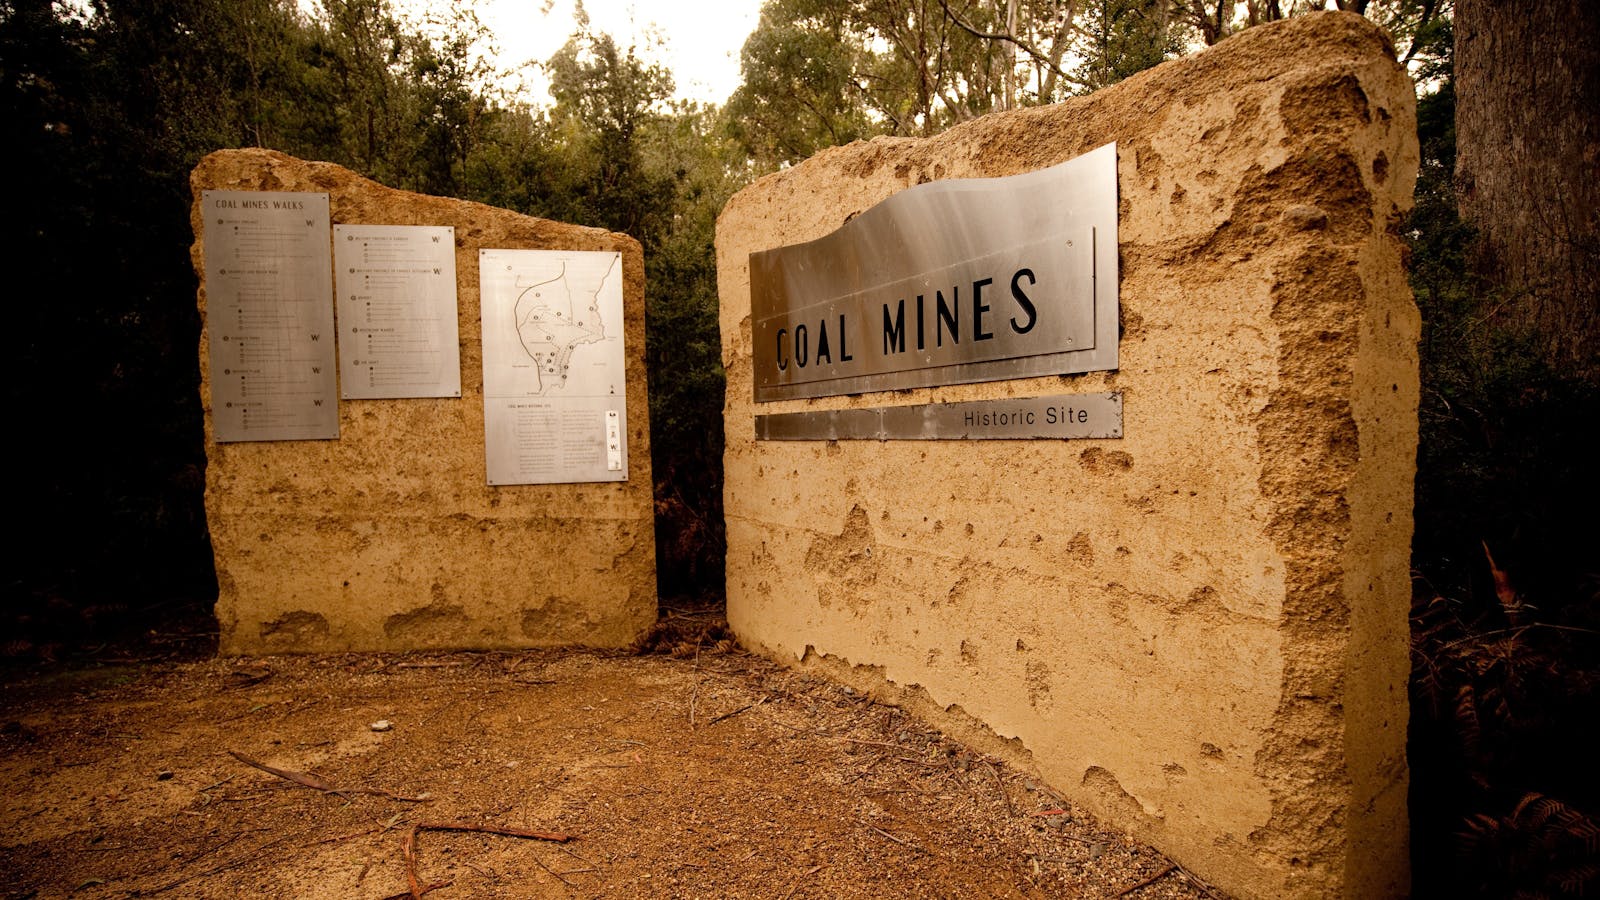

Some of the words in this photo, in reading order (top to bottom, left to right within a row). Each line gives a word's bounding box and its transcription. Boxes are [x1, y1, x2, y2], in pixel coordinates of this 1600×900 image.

[215, 199, 238, 209] COAL
[242, 200, 269, 209] MINES
[272, 201, 304, 210] WALKS
[776, 314, 853, 371] COAL
[883, 268, 1037, 355] MINES
[964, 409, 1035, 427] Historic
[1046, 406, 1088, 424] Site
